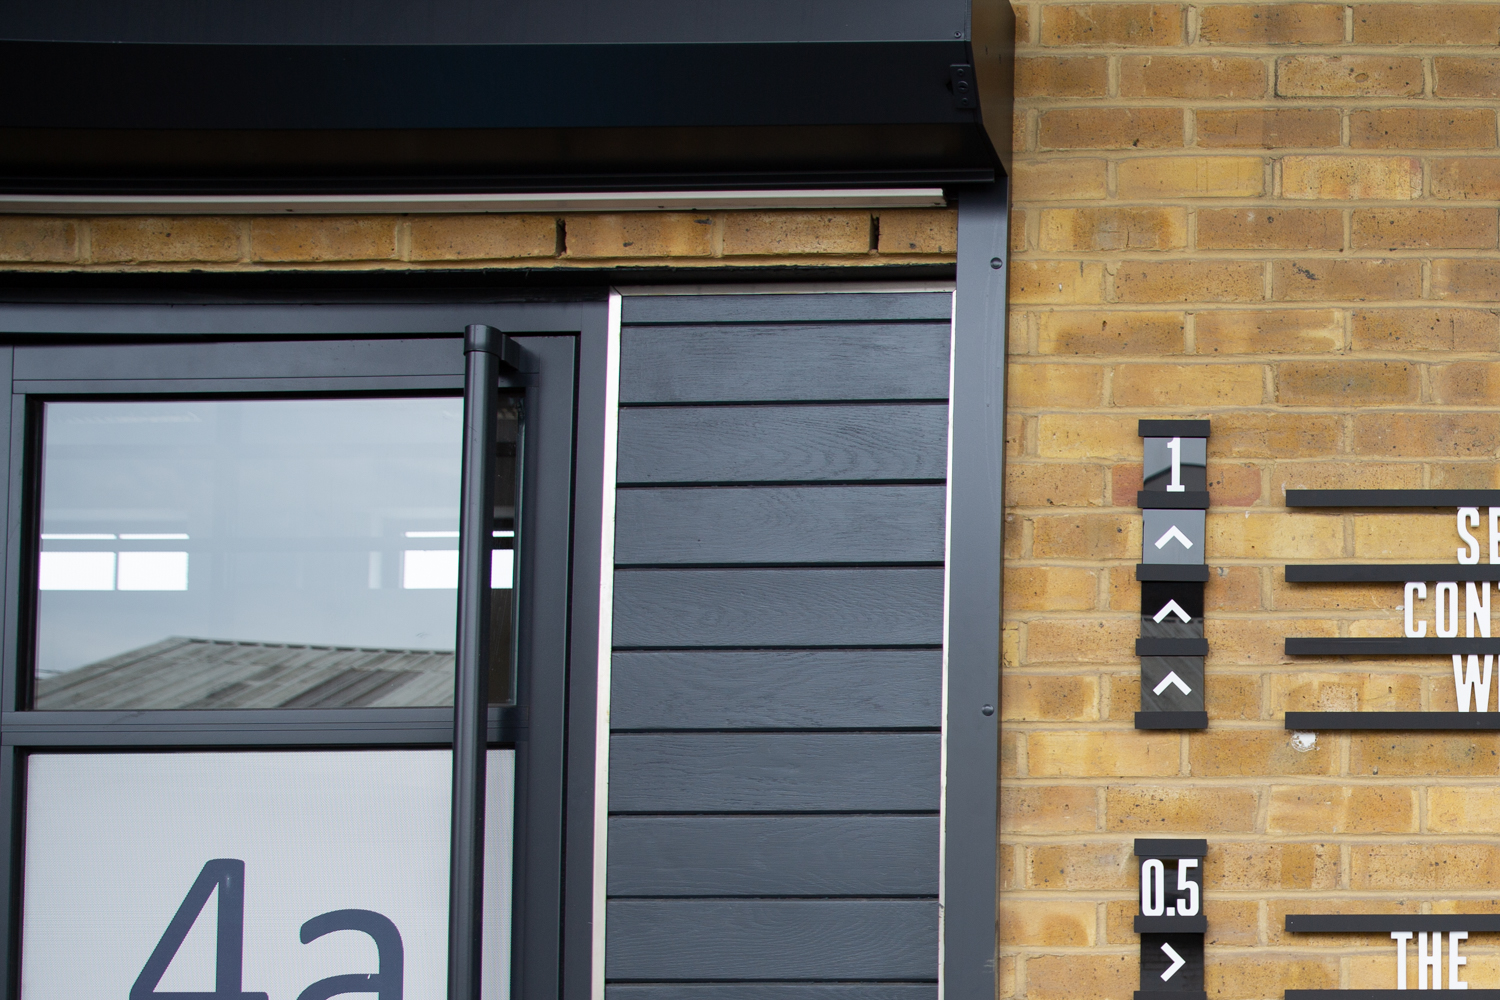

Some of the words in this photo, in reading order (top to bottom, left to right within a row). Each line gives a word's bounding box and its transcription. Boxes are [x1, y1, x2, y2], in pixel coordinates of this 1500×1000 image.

[1165, 436, 1186, 493] 1
[1140, 857, 1200, 917] 0.5
[1390, 930, 1469, 991] THE
